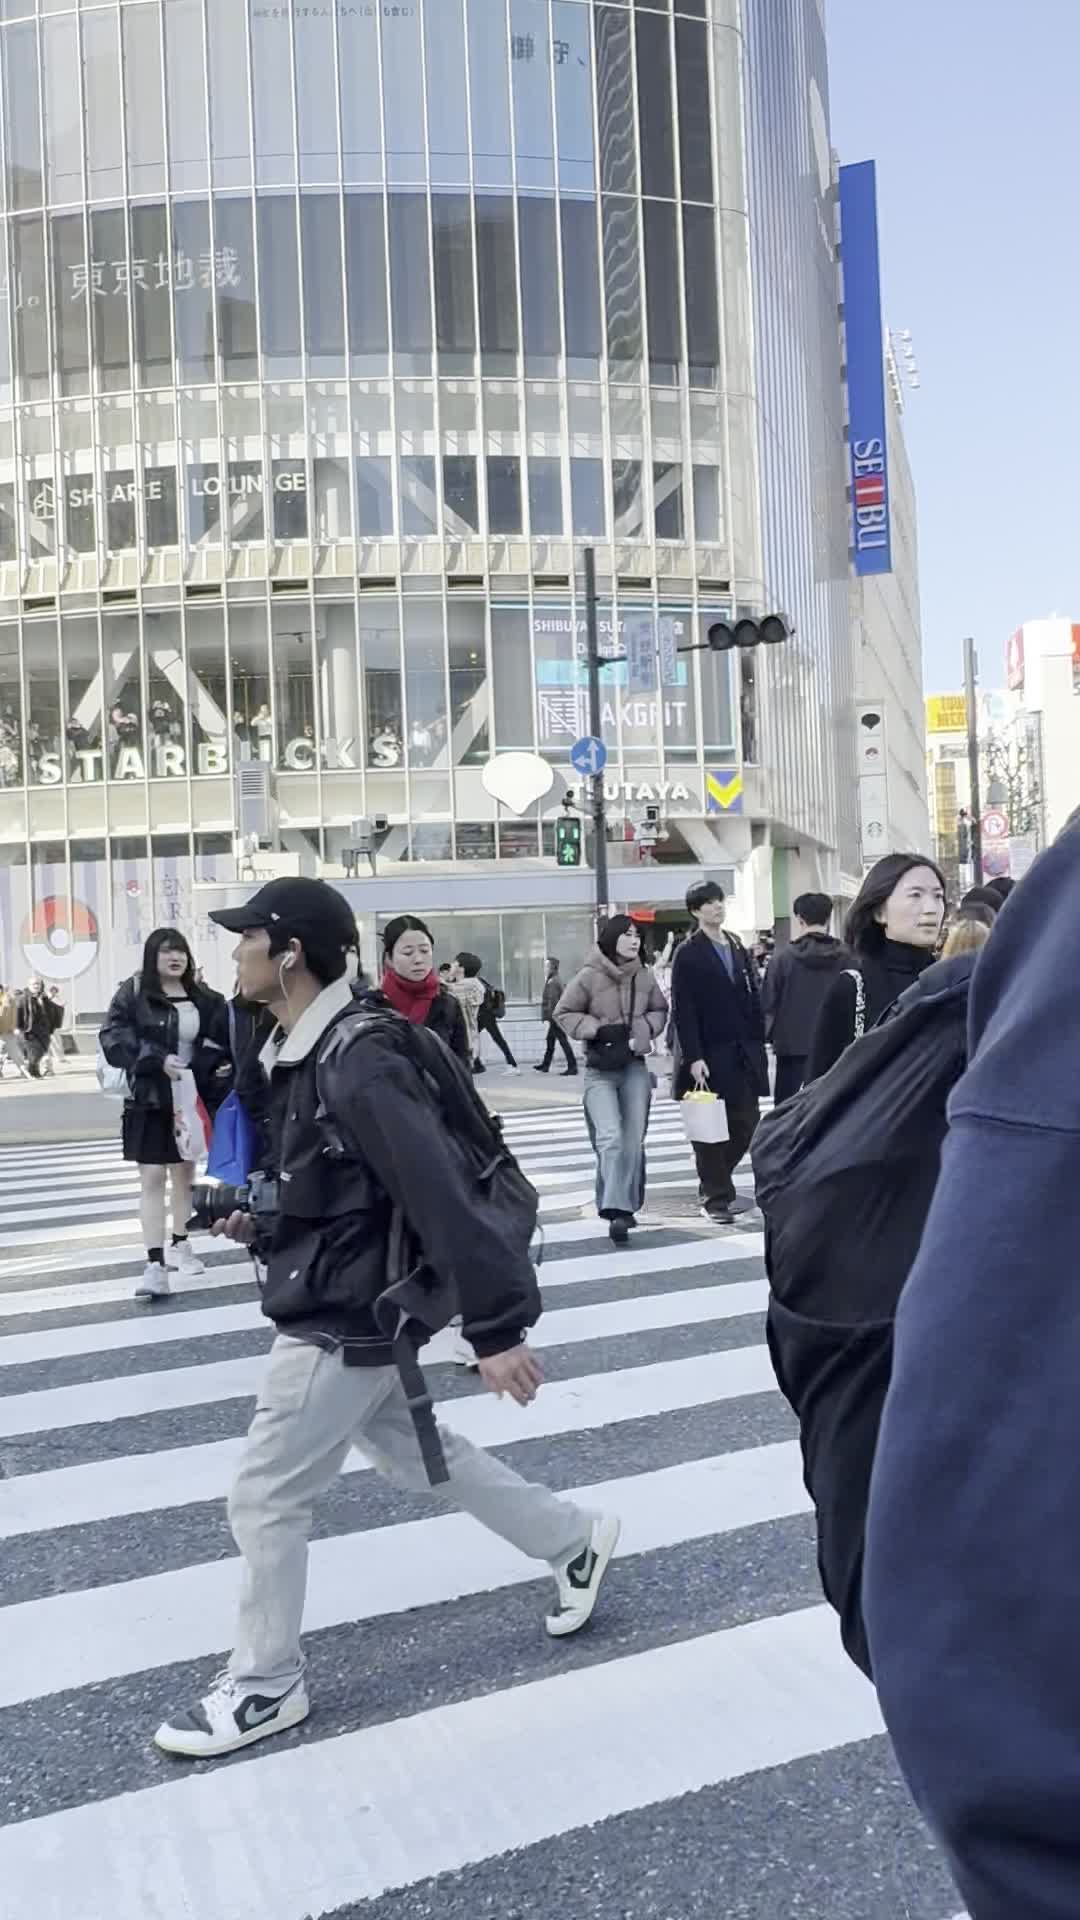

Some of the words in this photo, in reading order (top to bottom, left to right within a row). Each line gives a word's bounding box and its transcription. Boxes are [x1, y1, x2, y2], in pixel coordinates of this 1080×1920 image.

[69, 481, 162, 508] SHARE
[192, 472, 306, 497] LOUNGE
[854, 438, 886, 551] SEIBU
[39, 736, 403, 784] STARBCKS
